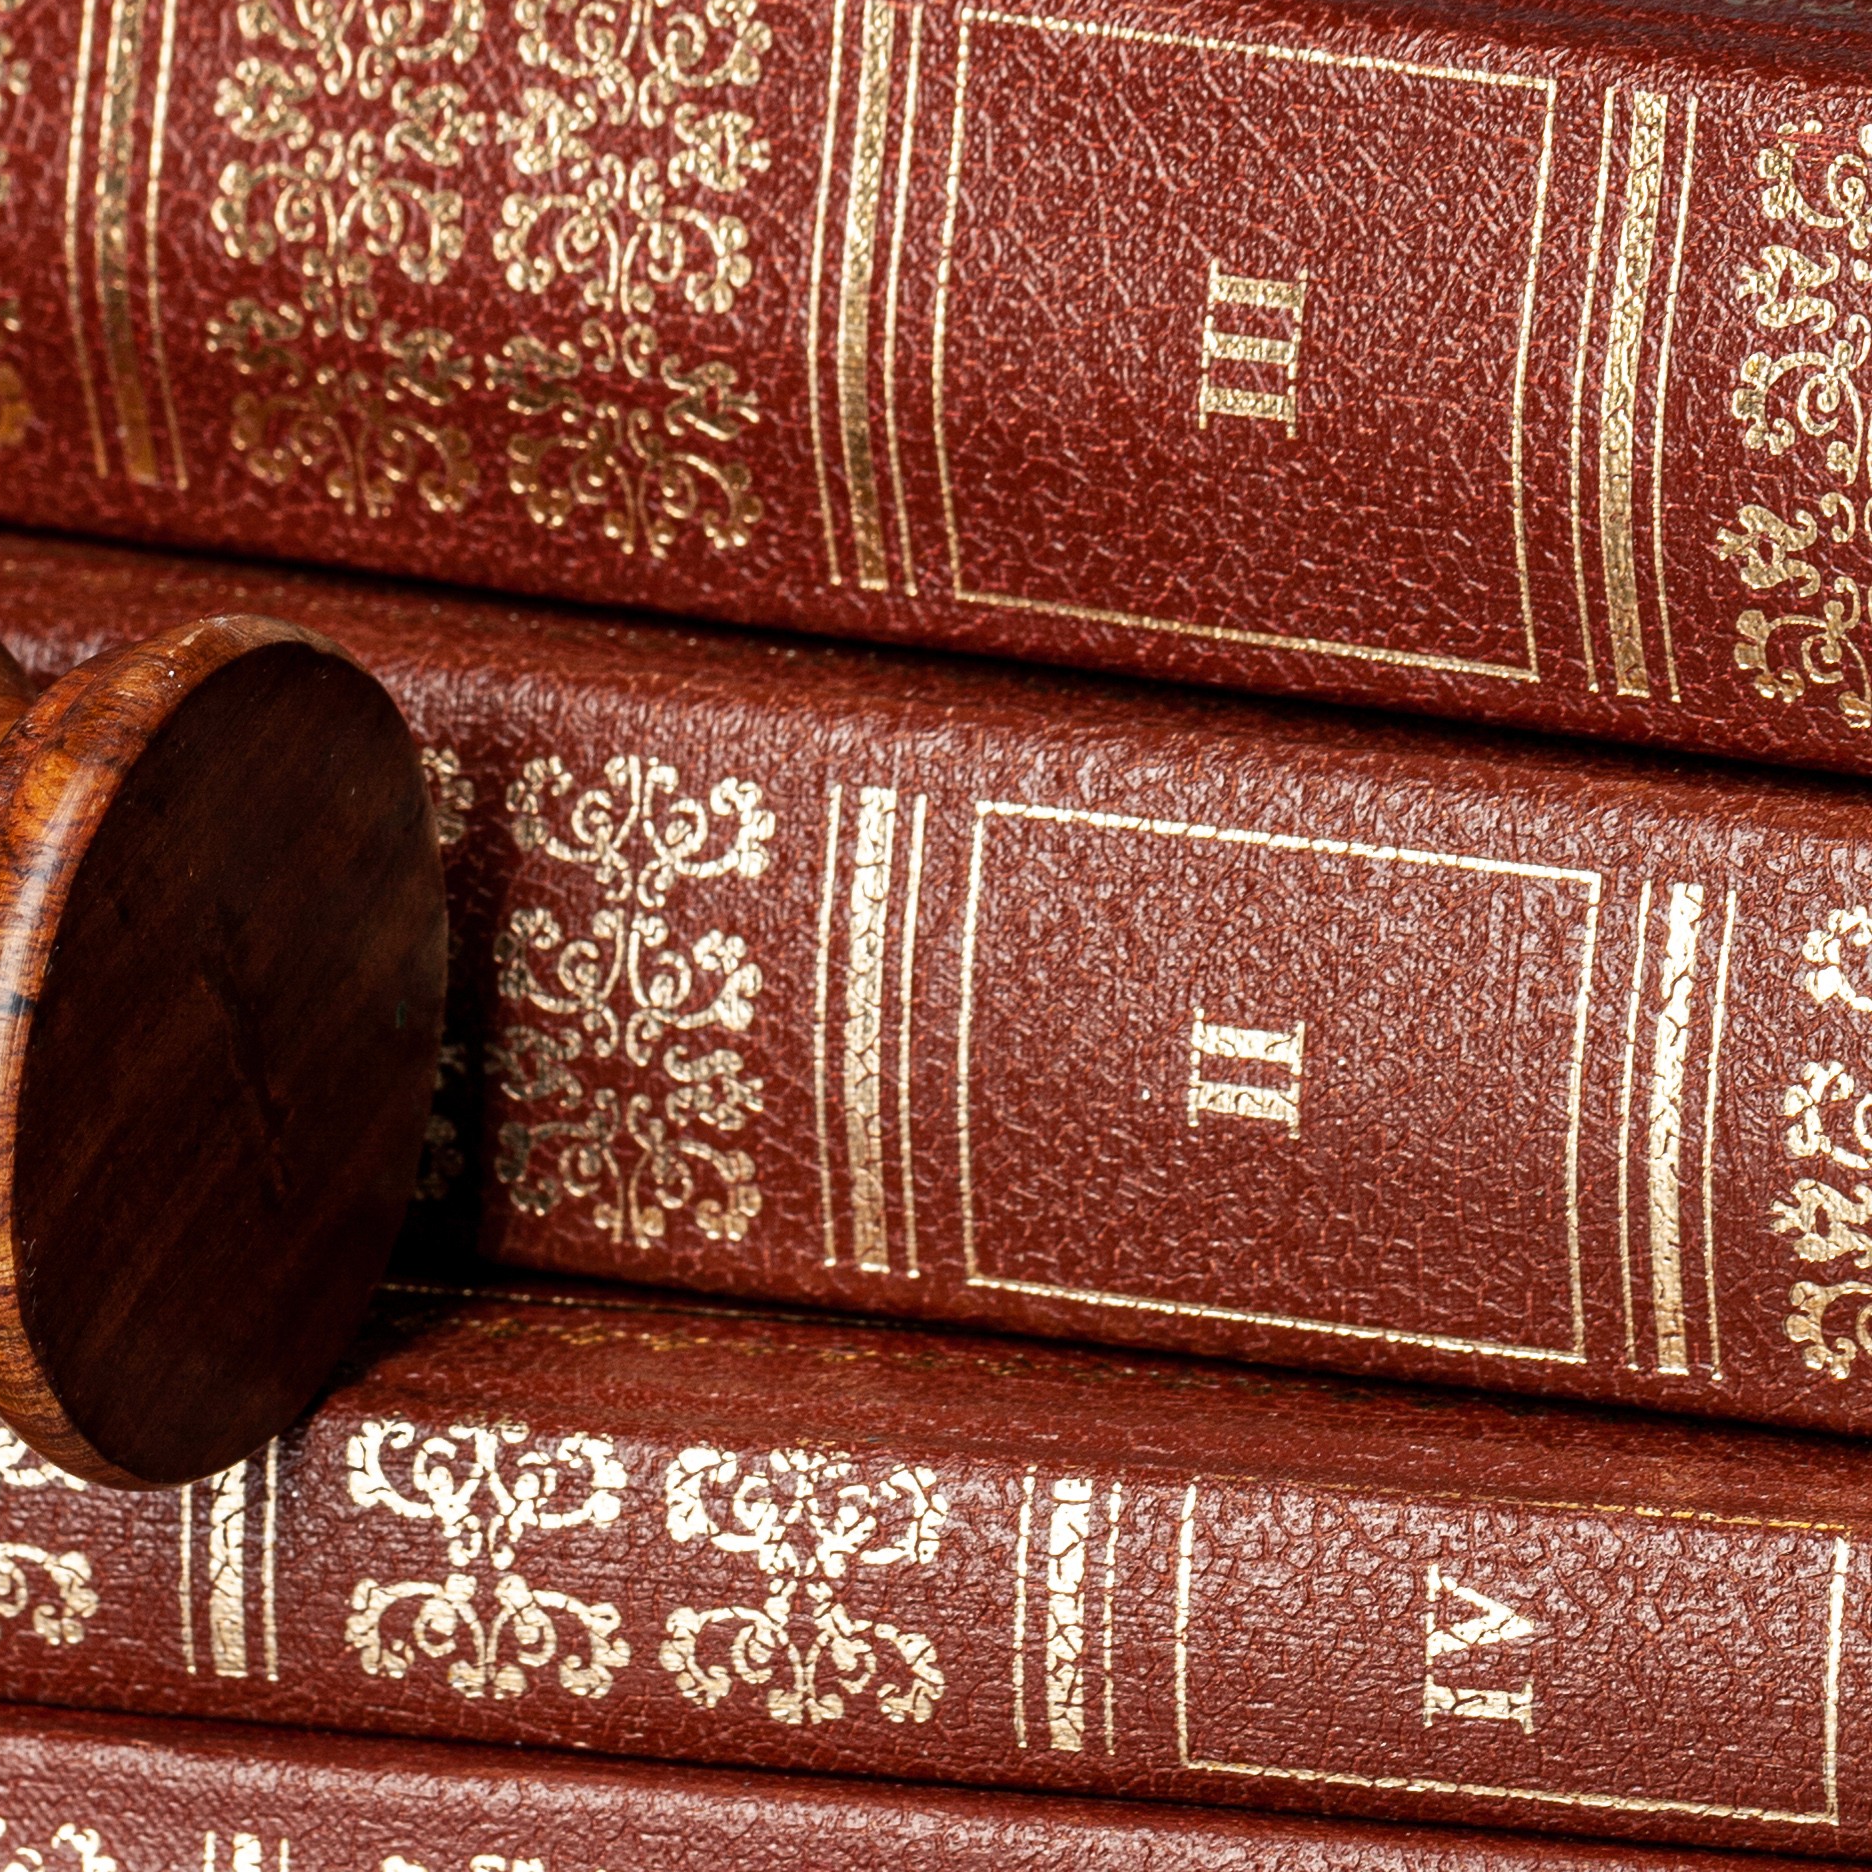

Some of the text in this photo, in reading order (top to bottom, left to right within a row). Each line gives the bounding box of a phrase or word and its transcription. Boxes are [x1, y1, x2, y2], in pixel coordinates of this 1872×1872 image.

[1198, 259, 1308, 438] III
[1188, 1006, 1307, 1140] II
[1423, 1562, 1537, 1736] IV
